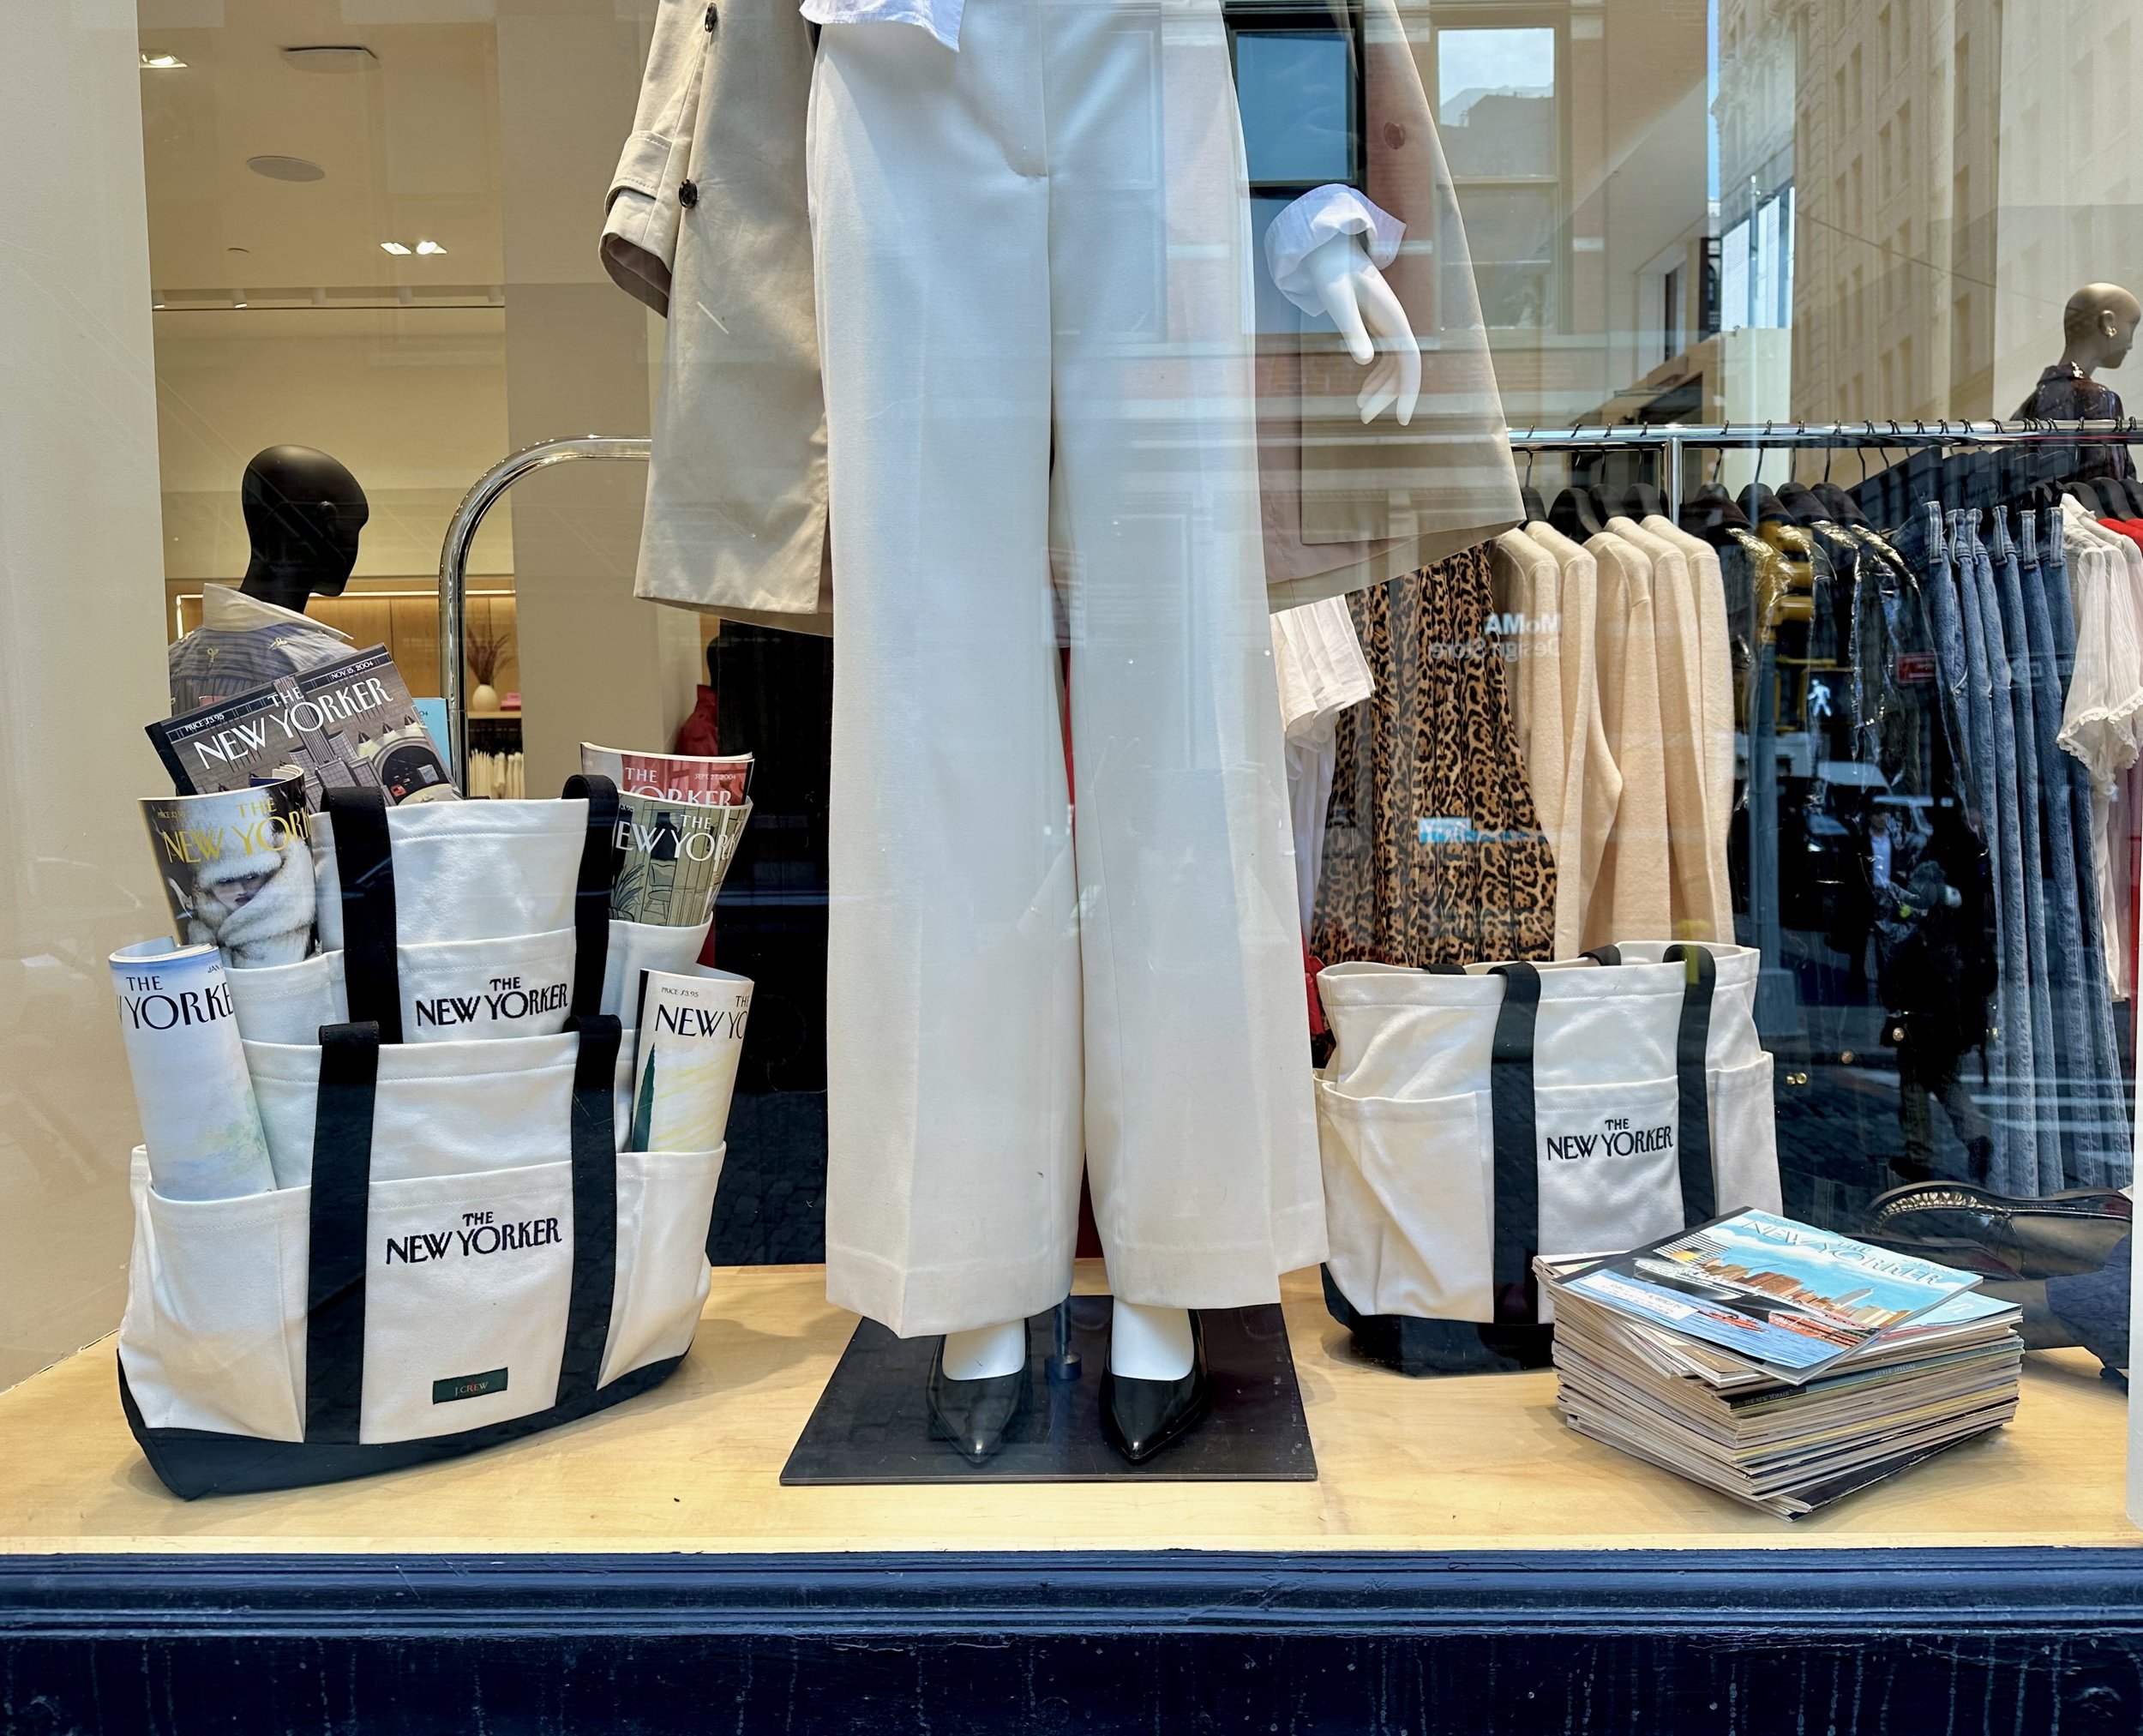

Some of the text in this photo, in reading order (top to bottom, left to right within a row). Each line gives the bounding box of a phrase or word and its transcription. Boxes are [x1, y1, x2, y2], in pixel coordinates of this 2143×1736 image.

[355, 661, 374, 671] 2004
[267, 687, 305, 707] THE
[194, 677, 393, 770] NEW YORKER
[625, 766, 657, 784] THE
[237, 797, 277, 818] THE
[680, 814, 712, 830] THE
[162, 806, 311, 864] NEW YORK
[615, 820, 737, 862] EW YORK
[125, 976, 164, 991] THE
[489, 976, 521, 990] THE
[661, 987, 678, 995] PRICE
[124, 982, 234, 1030] YORKE
[415, 982, 568, 1027] NEW YORKER
[655, 1003, 725, 1037] NEW
[1605, 1118, 1630, 1131] THE
[1546, 1126, 1673, 1161] NEW YORKER
[462, 1210, 495, 1227] THE
[386, 1216, 562, 1265] NEW YORKER
[1742, 1220, 1818, 1246] NEW
[1815, 1242, 1944, 1286] YORKER
[453, 1381, 489, 1397] J.CREW
